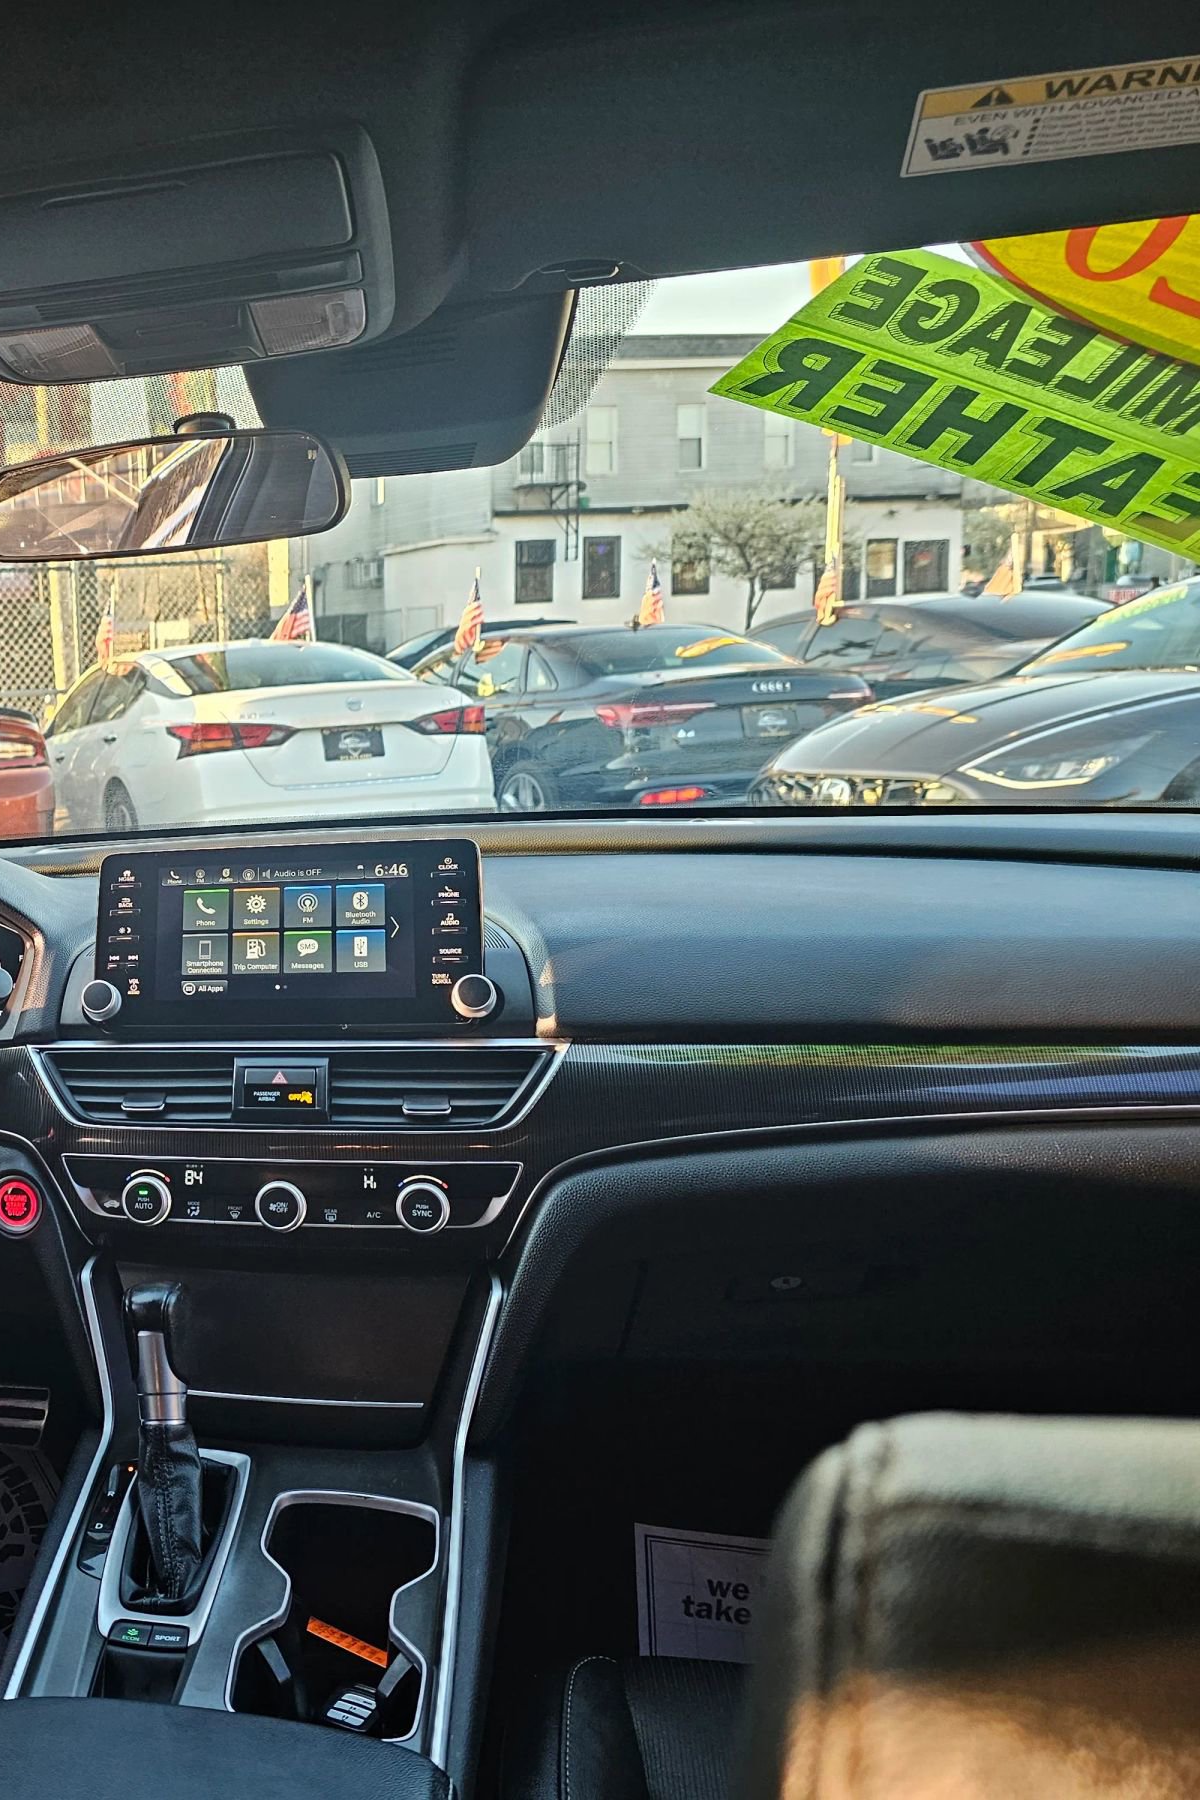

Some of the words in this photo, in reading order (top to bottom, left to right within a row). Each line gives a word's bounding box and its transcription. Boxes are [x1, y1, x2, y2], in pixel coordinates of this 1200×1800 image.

[953, 110, 1007, 126] EVEN
[1013, 104, 1065, 119] WITH
[1067, 90, 1183, 112] ADVANCED
[274, 869, 296, 877] Audio
[297, 869, 304, 877] is
[305, 868, 322, 877] OFF
[374, 863, 408, 877] 6:46
[243, 918, 269, 926] Settings
[186, 960, 224, 968] Smartphone
[233, 963, 247, 971] Trip
[247, 963, 279, 971] Computer
[291, 962, 325, 970] Messages
[208, 985, 224, 993] Apps
[288, 1093, 302, 1101] OFF
[184, 1169, 204, 1186] 84
[134, 1202, 153, 1210] AUTO
[366, 1211, 381, 1219] A/C
[411, 1209, 433, 1218] SYNC
[706, 1578, 750, 1601] we
[681, 1594, 752, 1626] take
[154, 1634, 182, 1642] SPORT
